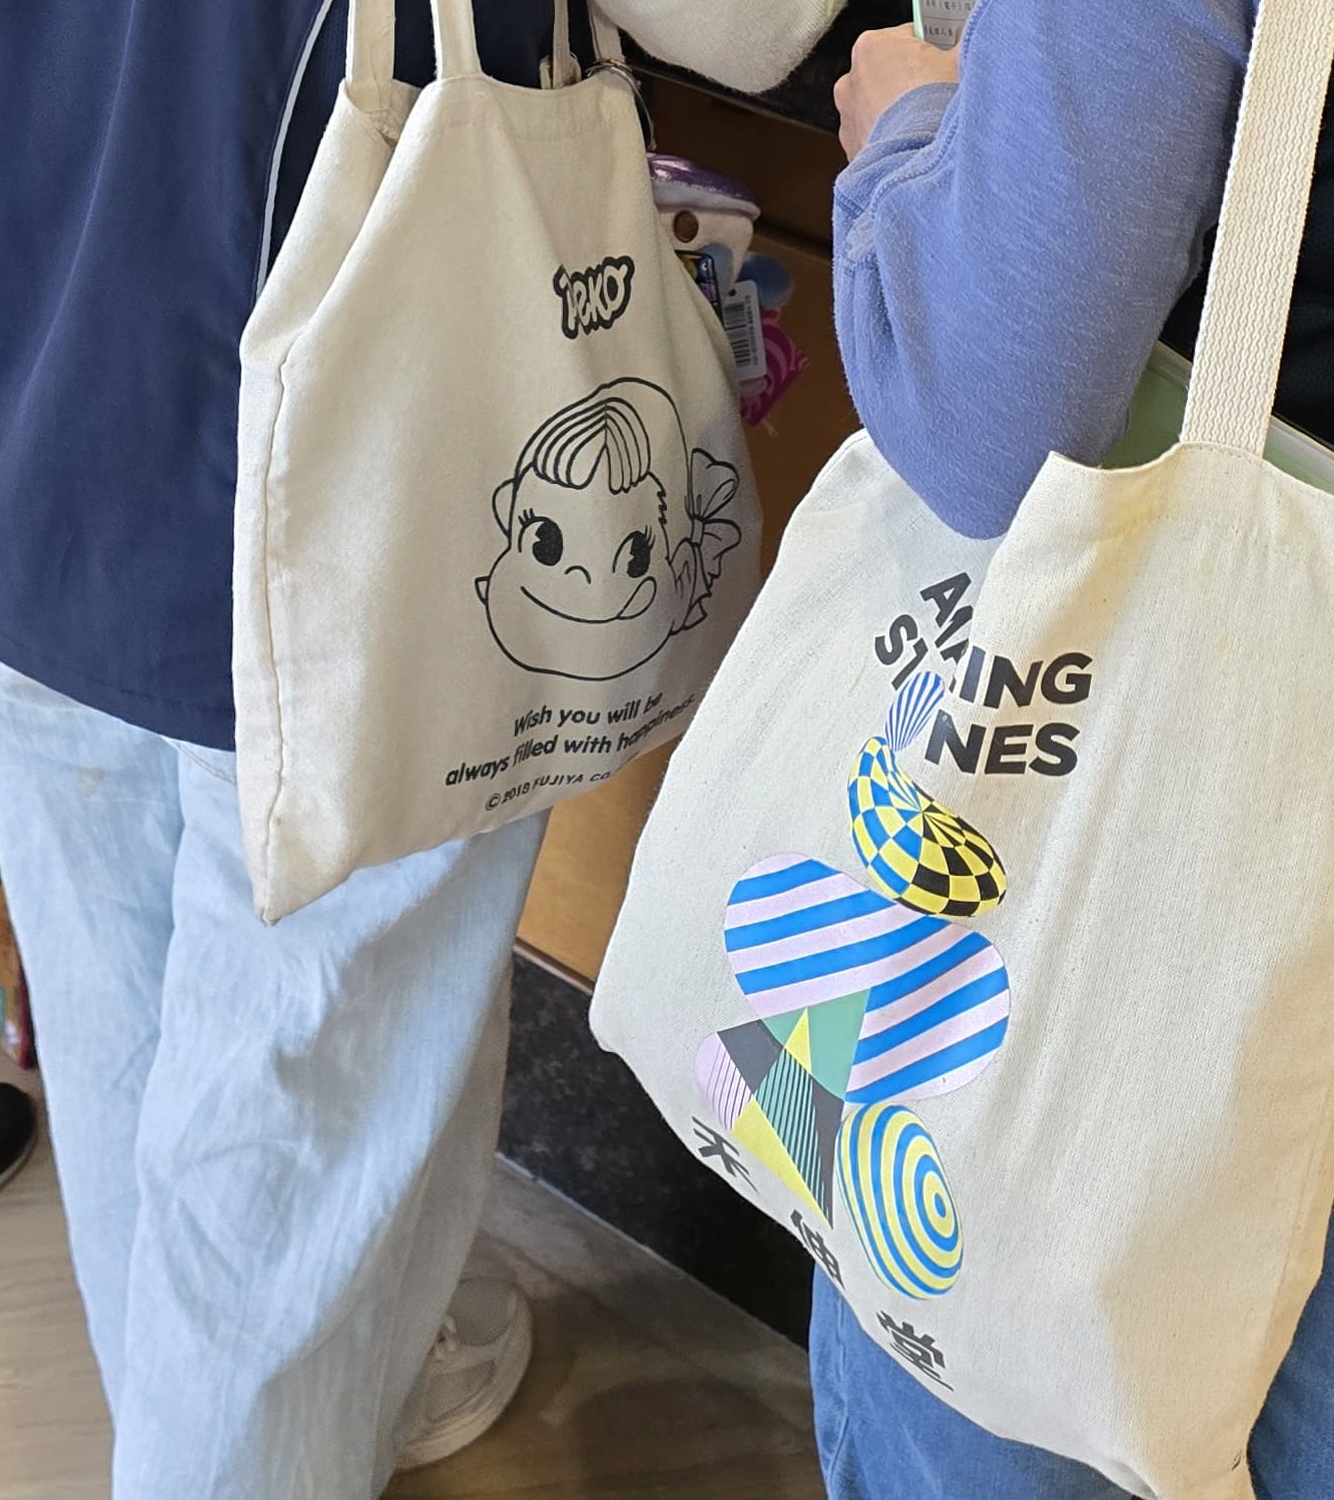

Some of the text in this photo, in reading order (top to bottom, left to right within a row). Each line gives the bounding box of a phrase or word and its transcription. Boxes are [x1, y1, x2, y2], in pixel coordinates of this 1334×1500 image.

[514, 705, 552, 737] Wish
[557, 710, 601, 728] you
[607, 702, 640, 724] will
[445, 757, 509, 786] always
[512, 735, 558, 767] filled
[563, 735, 612, 754] with
[531, 775, 584, 790] FUJIYA
